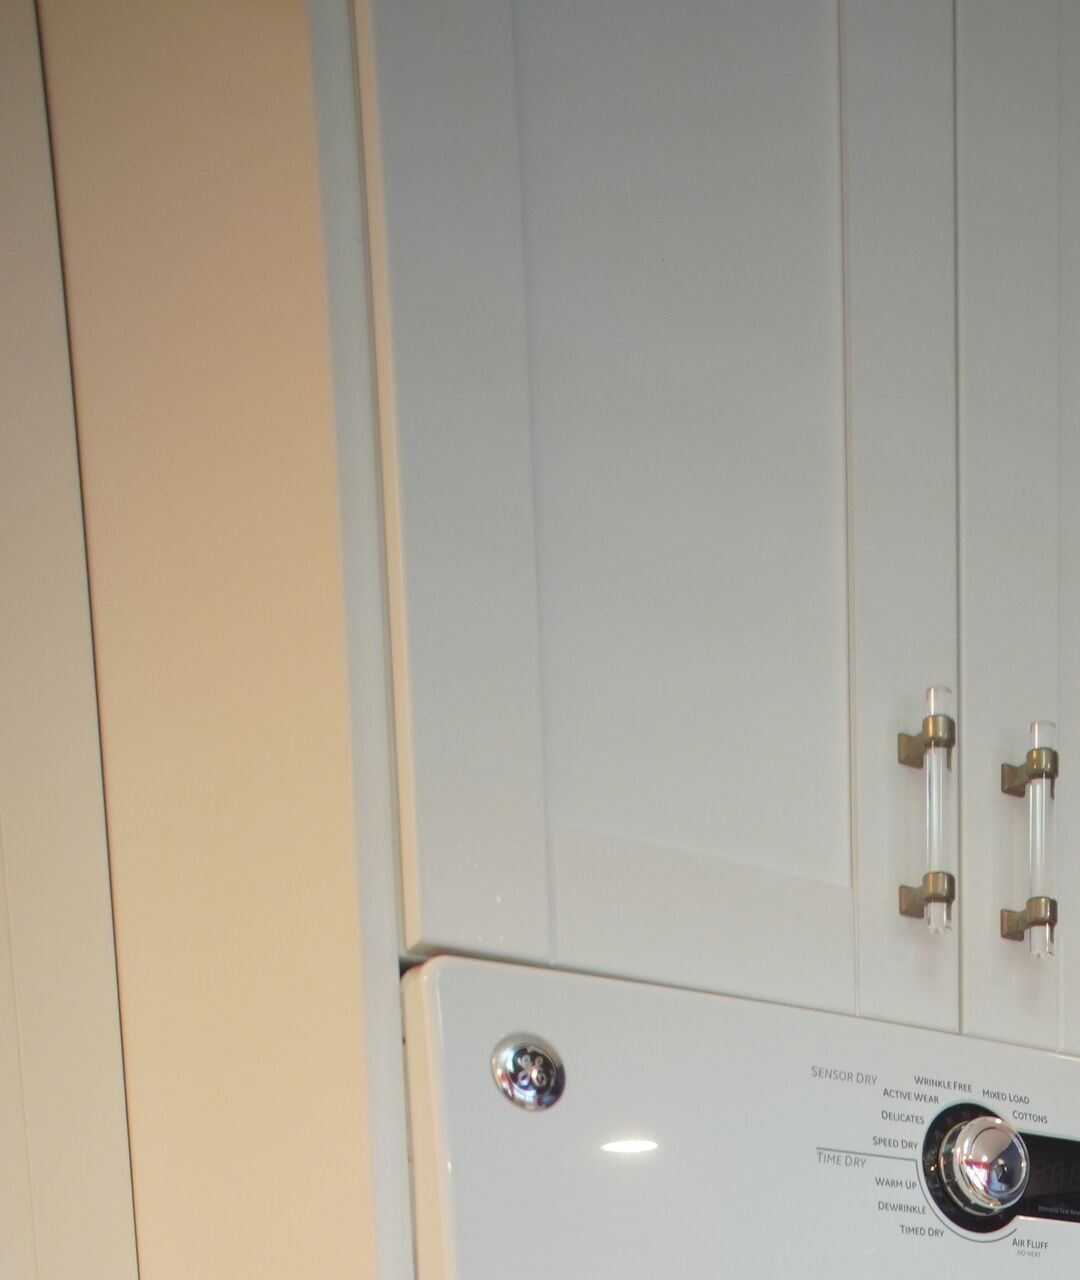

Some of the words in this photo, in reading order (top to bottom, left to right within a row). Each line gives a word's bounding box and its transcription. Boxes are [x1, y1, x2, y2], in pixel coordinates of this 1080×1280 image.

[811, 1065, 853, 1082] SENSOR
[856, 1072, 878, 1086] DRY
[914, 1075, 952, 1090] WRINKLE
[953, 1081, 973, 1093] FREE
[882, 1088, 912, 1101] ACTIVE
[913, 1092, 939, 1104] WEAR
[982, 1089, 1007, 1101] MIXED
[1009, 1093, 1030, 1105] LOAD
[881, 1110, 925, 1125] DELICATES
[1012, 1110, 1048, 1124] COTTONS
[872, 1136, 899, 1148] SPEED
[901, 1139, 918, 1150] DRY
[816, 1151, 842, 1166] TIME
[844, 1154, 867, 1168] DRY
[875, 1176, 903, 1188] WARM
[905, 1180, 917, 1190] UP
[878, 1200, 927, 1215] DEWRINKLE
[900, 1224, 926, 1236] TIMED
[928, 1227, 944, 1238] DRY
[1012, 1237, 1025, 1248] AIR
[1027, 1239, 1049, 1250] FLUFF
